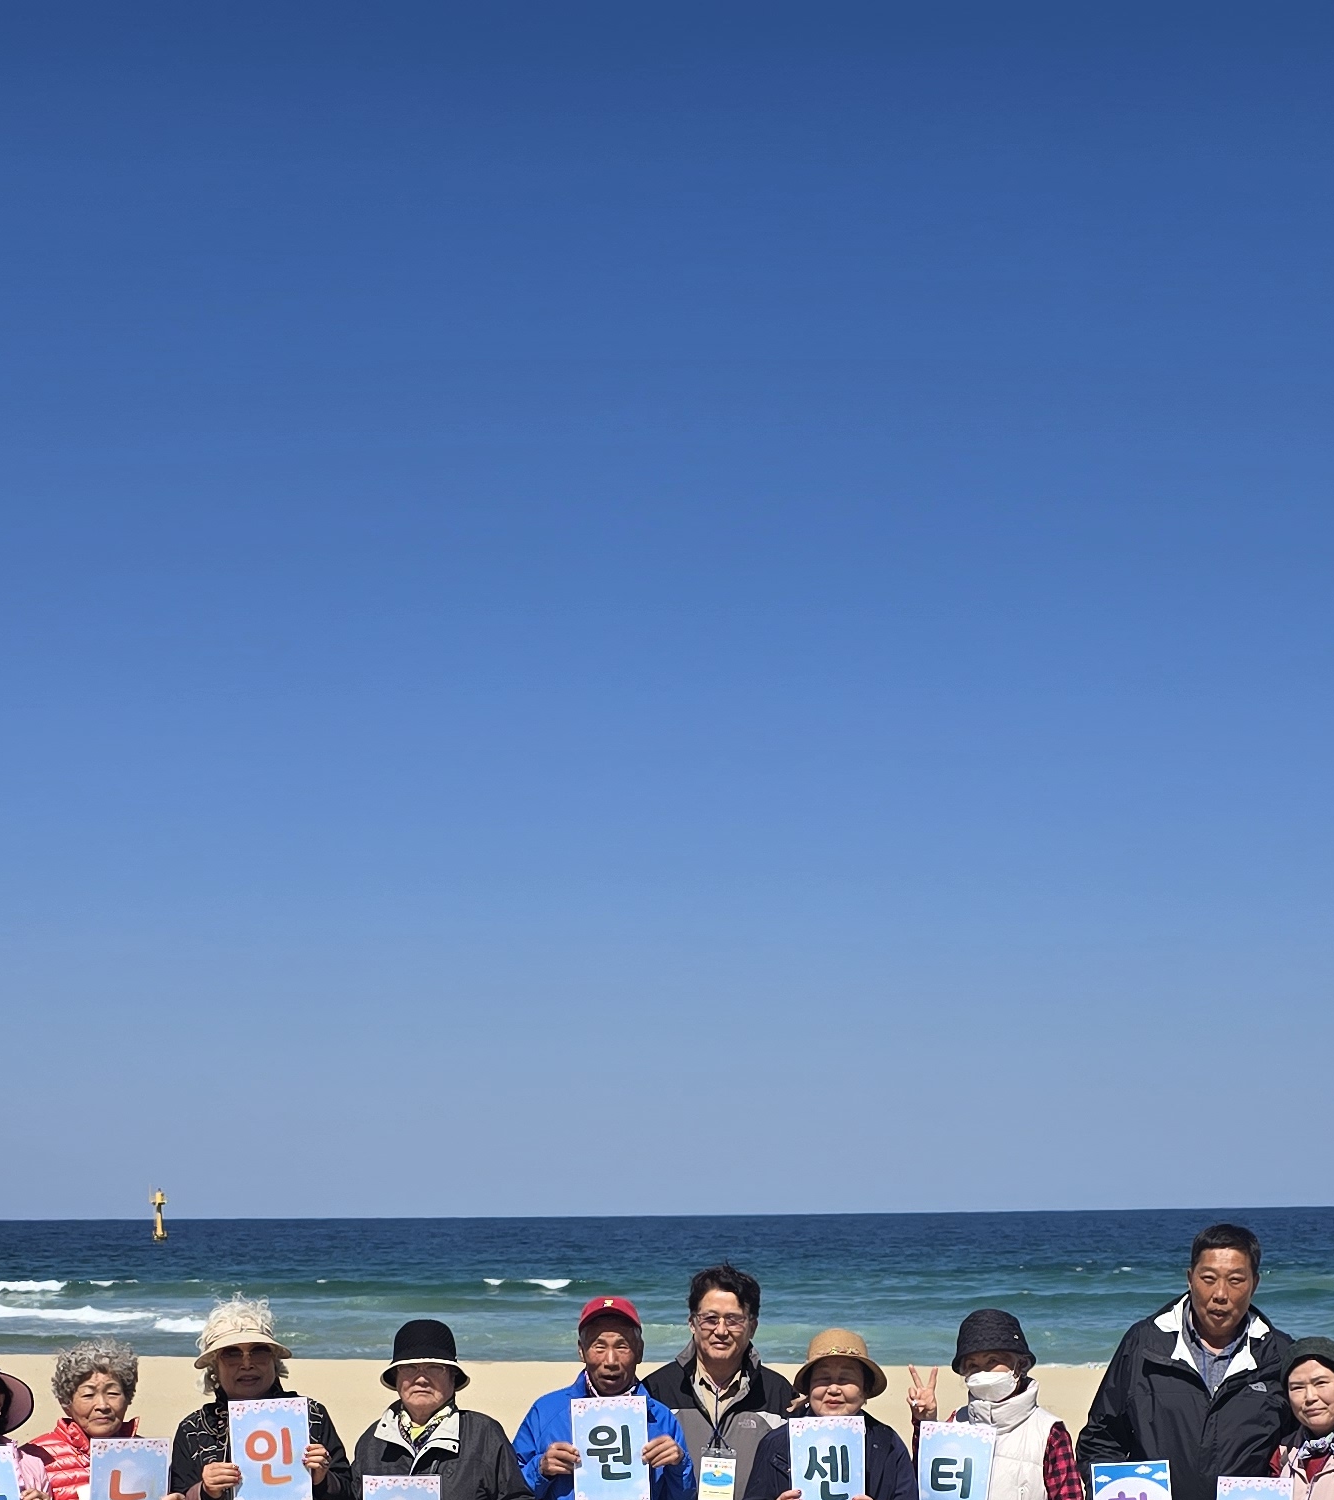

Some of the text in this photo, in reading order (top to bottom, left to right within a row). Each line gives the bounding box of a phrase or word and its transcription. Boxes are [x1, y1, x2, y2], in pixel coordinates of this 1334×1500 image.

[244, 1427, 292, 1485] 인
[586, 1425, 631, 1480] 원
[930, 1457, 972, 1500] 터
